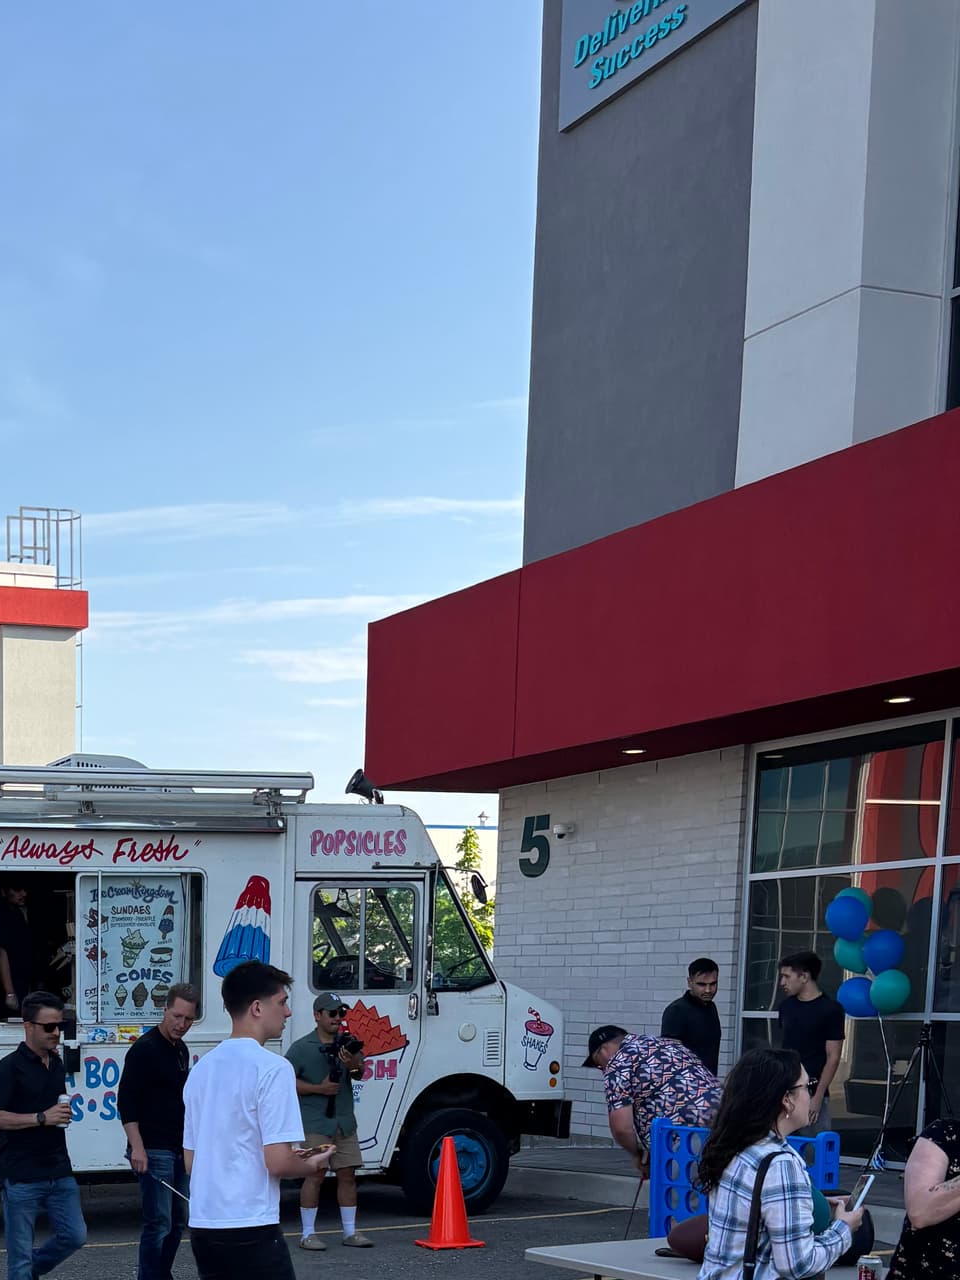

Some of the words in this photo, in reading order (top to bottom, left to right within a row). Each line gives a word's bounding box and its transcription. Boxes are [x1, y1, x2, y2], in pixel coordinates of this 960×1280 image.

[588, 4, 688, 89] Success
[310, 829, 408, 857] POPSICLES
[518, 814, 551, 878] 5
[111, 905, 151, 915] SUNDAES
[115, 968, 174, 984] CONES
[521, 1035, 549, 1055] SHAKES
